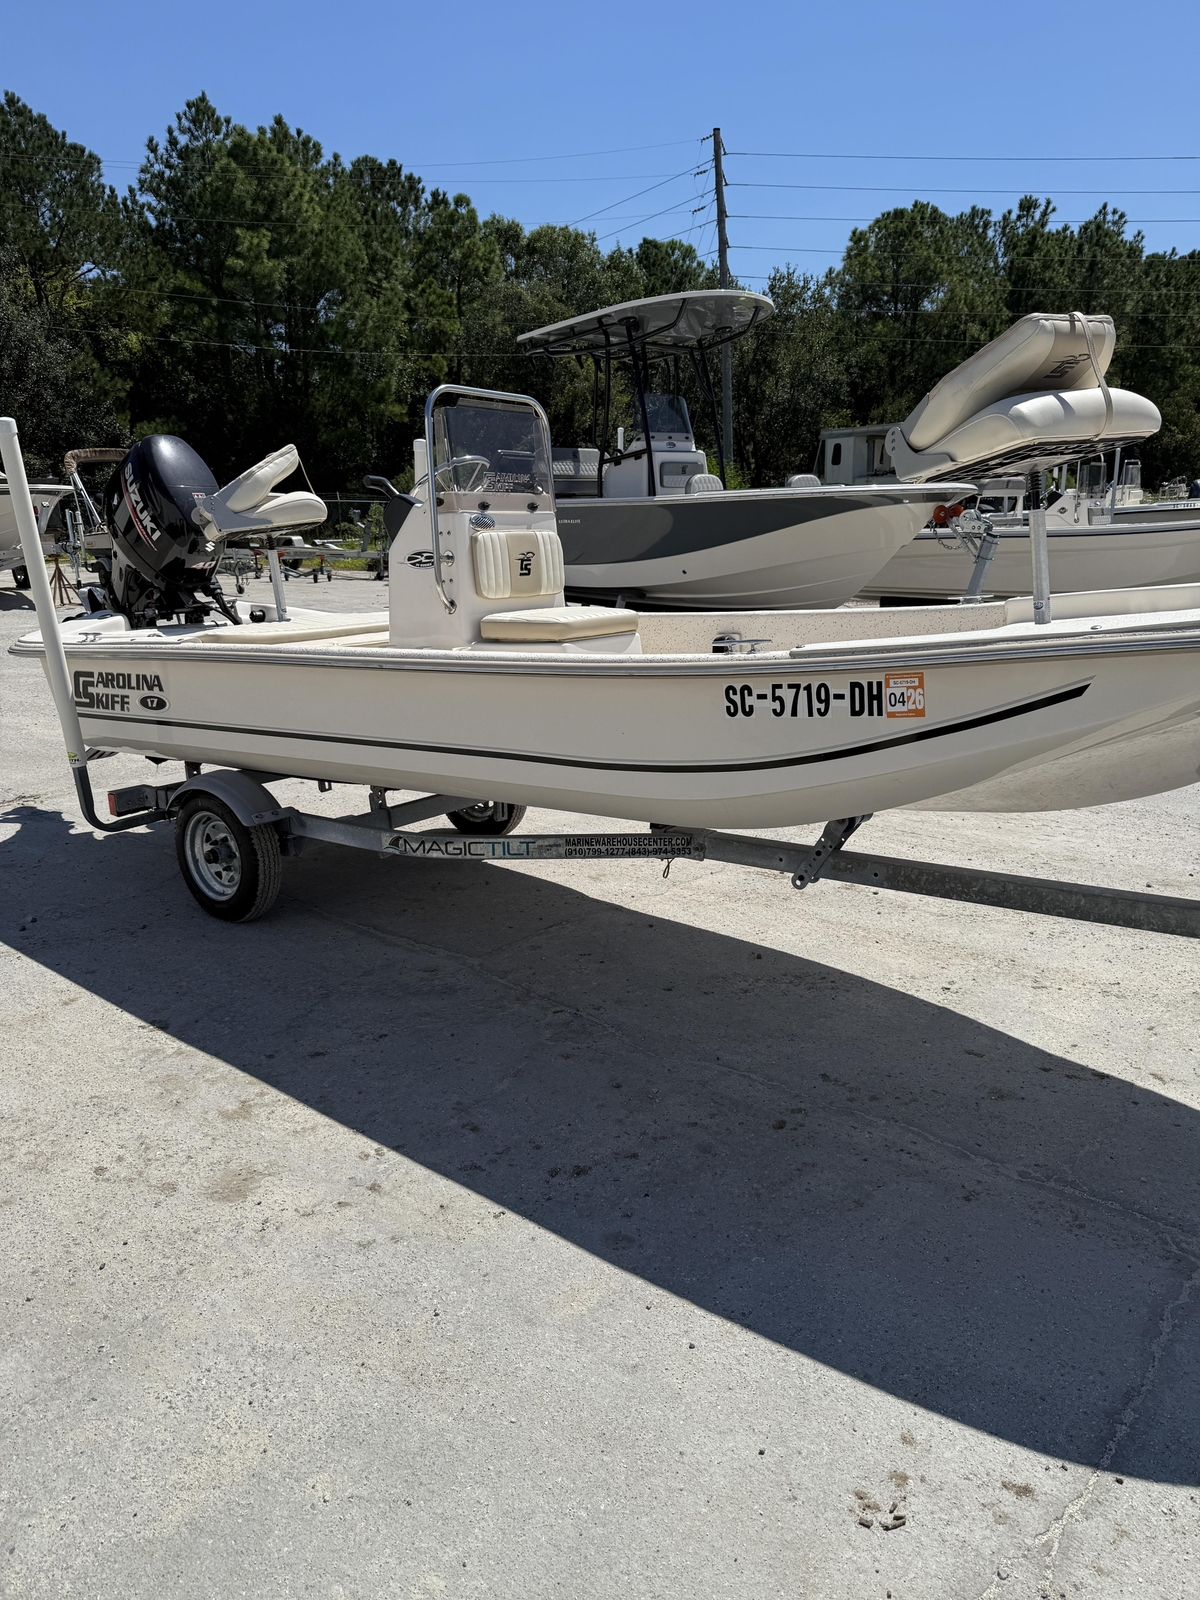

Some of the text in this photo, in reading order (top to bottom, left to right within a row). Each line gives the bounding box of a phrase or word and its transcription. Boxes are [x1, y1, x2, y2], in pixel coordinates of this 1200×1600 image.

[125, 462, 161, 542] SUZUKI
[191, 560, 216, 570] 40
[74, 671, 165, 694] CAROLINA
[146, 698, 158, 708] 17
[725, 681, 883, 717] SC-5719-DH
[888, 687, 925, 710] 04 26
[404, 838, 536, 856] MAGICTILT
[565, 837, 692, 847] MARINEWAREHOUSECENTER.COM
